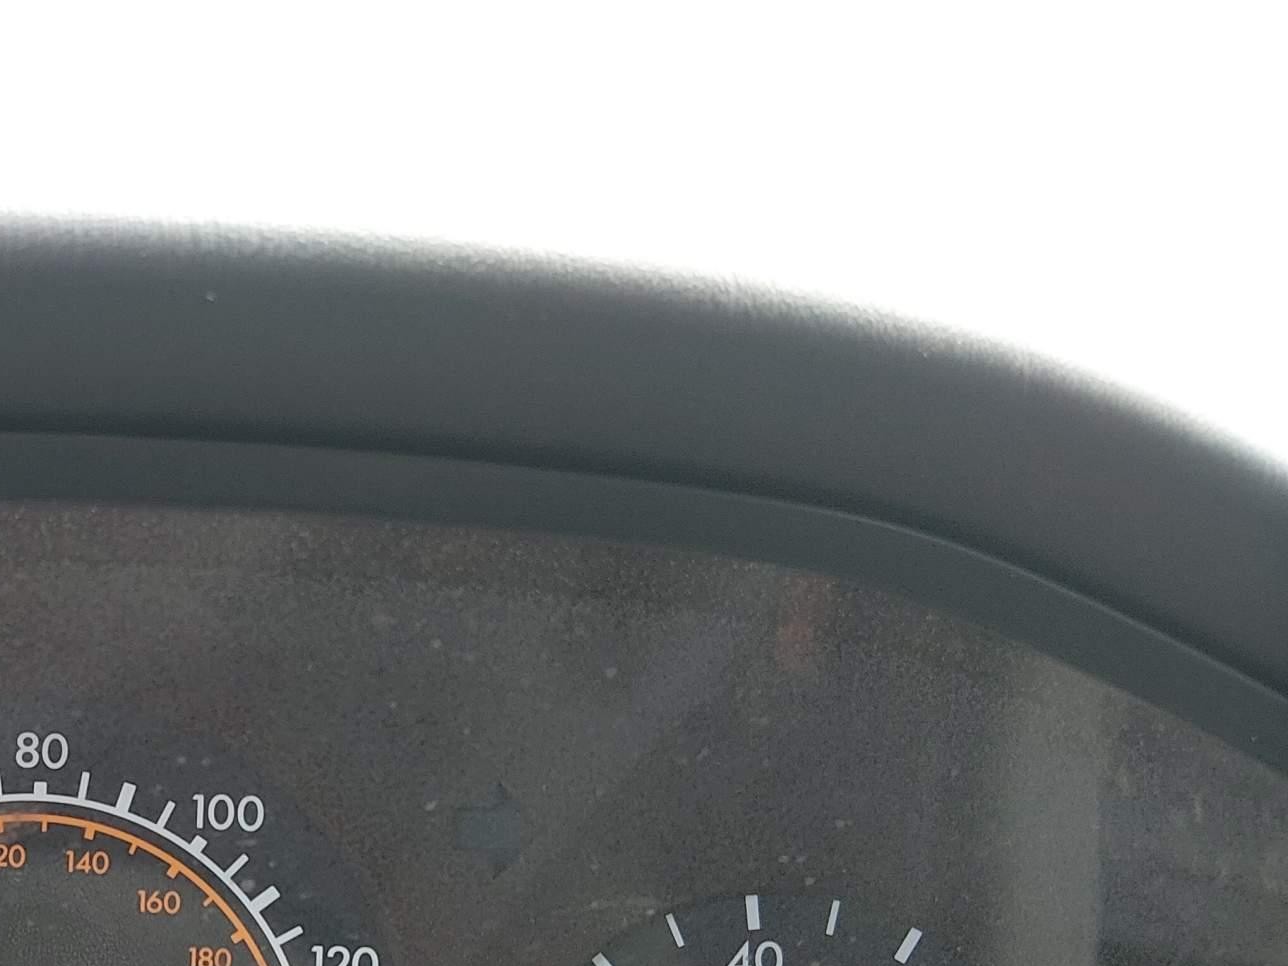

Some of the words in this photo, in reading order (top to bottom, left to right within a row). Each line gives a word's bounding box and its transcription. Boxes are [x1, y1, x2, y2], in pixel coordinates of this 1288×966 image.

[16, 732, 68, 769] 80
[193, 794, 264, 831] 100
[67, 851, 109, 873] 140
[137, 892, 180, 913] 160
